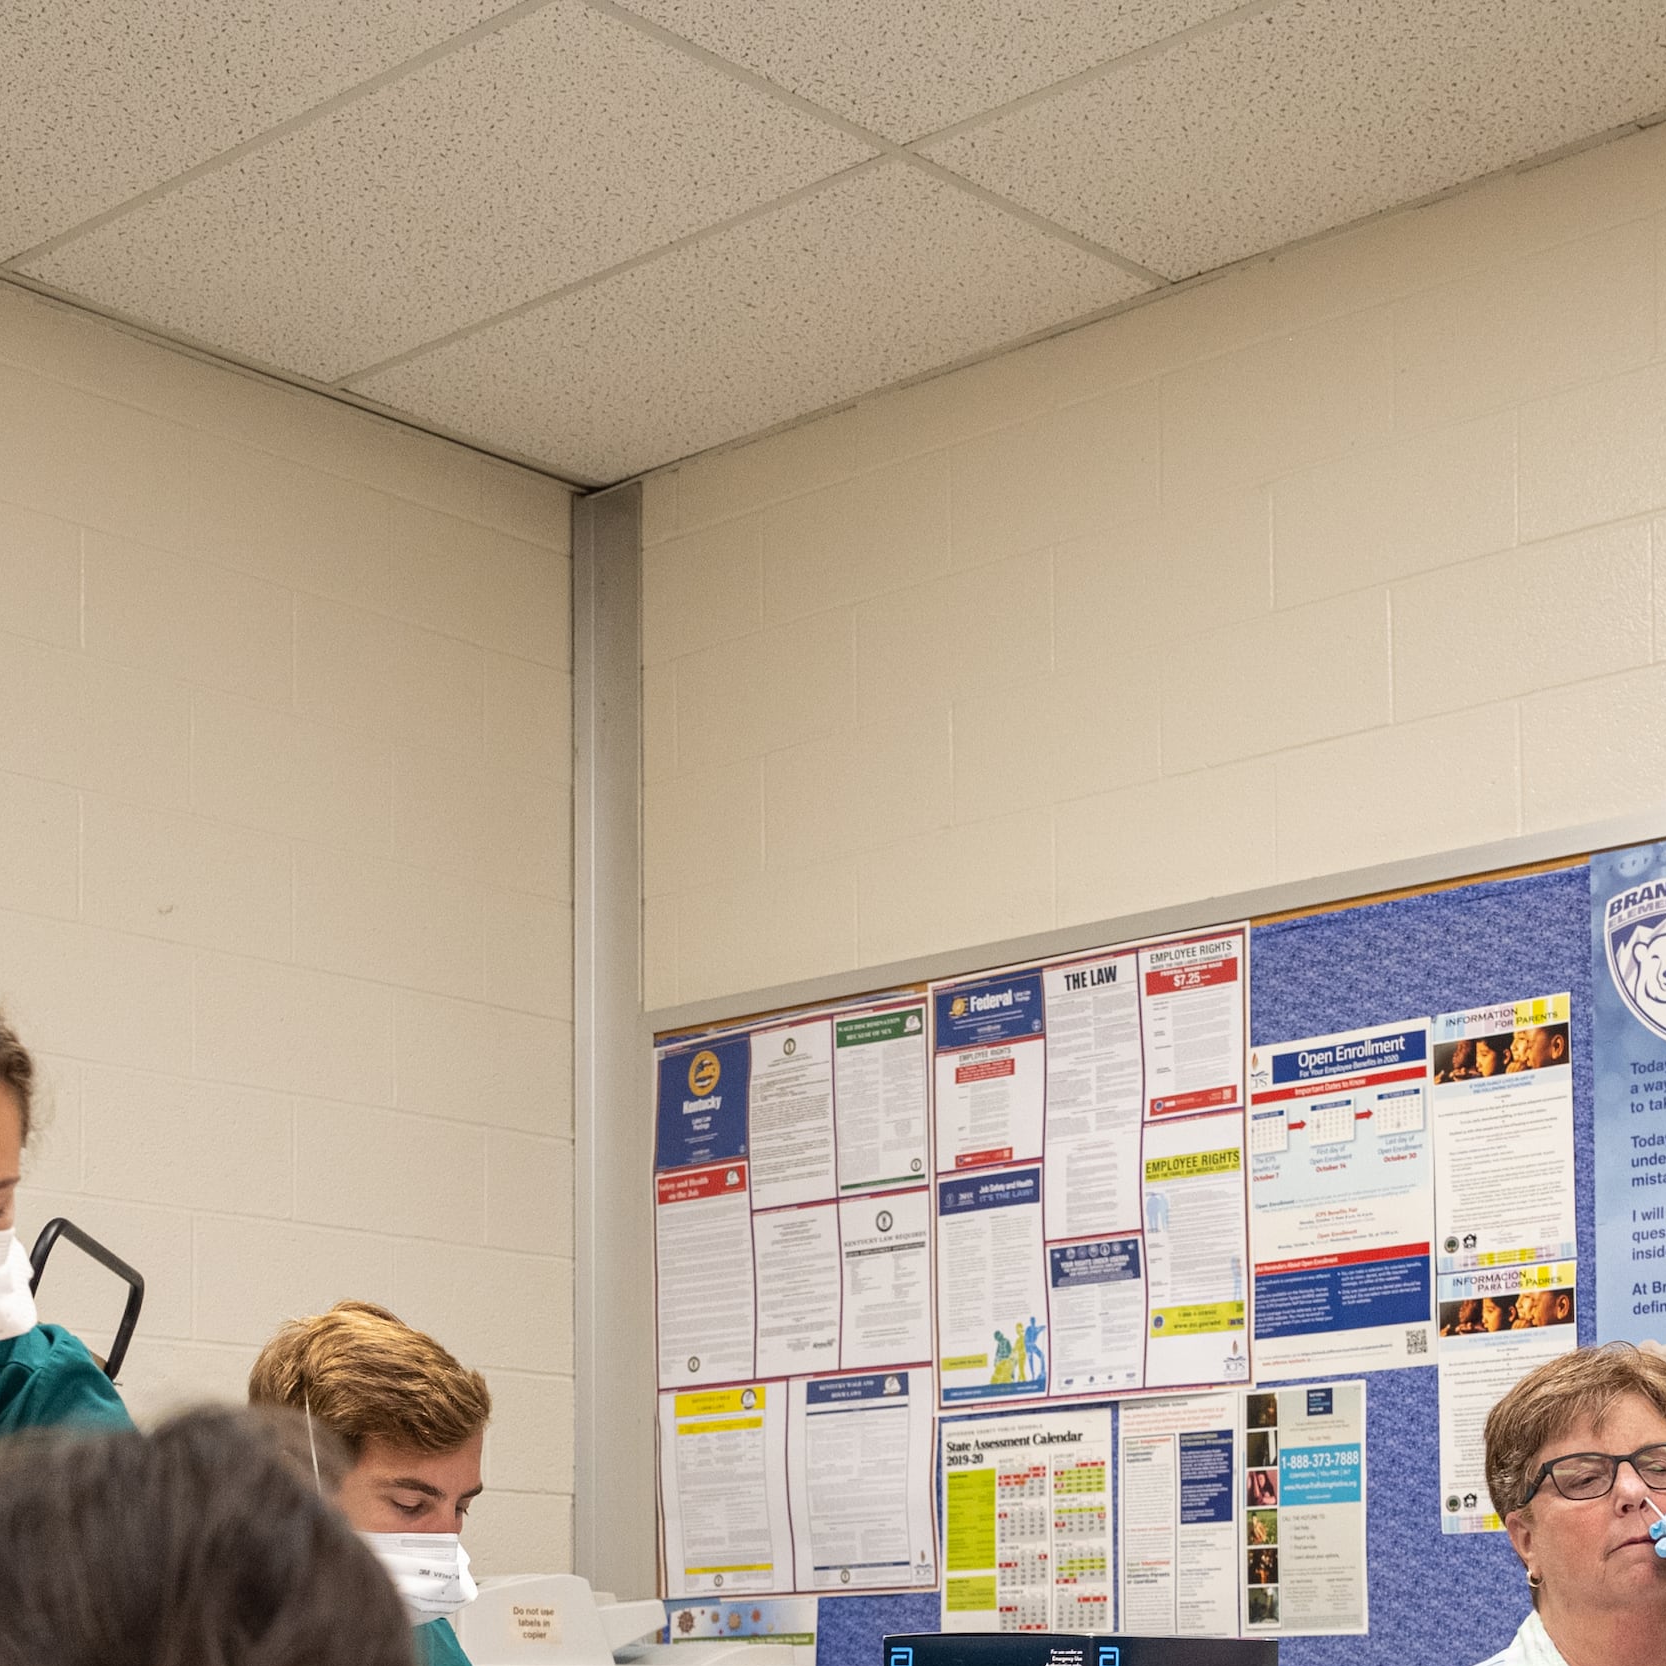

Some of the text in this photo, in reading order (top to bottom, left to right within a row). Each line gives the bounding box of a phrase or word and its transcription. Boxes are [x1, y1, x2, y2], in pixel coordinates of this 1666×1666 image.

[1150, 941, 1232, 963] EMPLOYEE RIGHTS
[1065, 965, 1117, 991] THE LAW
[1173, 973, 1201, 987] $7.25
[970, 989, 1013, 1013] Federal
[1446, 1008, 1518, 1027] INFORMATION
[1516, 1011, 1558, 1025] PARENTS
[1298, 1036, 1405, 1070] Open Enrollment
[1299, 1069, 1310, 1078] For
[1310, 1067, 1324, 1077] Your
[1324, 1063, 1352, 1076] Employee
[1353, 1057, 1376, 1070] Benefits
[1382, 1054, 1400, 1065] 2020
[1630, 1084, 1639, 1094] a
[683, 1095, 722, 1115] Kentucky
[1630, 1101, 1644, 1113] to
[1146, 1150, 1240, 1175] EMPLOYEE RIGHTS
[1632, 1282, 1647, 1296] At
[946, 1431, 1083, 1454] State Assessment Calendar
[947, 1454, 984, 1466] 2019-20
[1281, 1451, 1359, 1469] 1-888-373-7888
[513, 1607, 554, 1616] Do not use
[518, 1618, 550, 1628] labels in
[522, 1630, 546, 1640] copier
